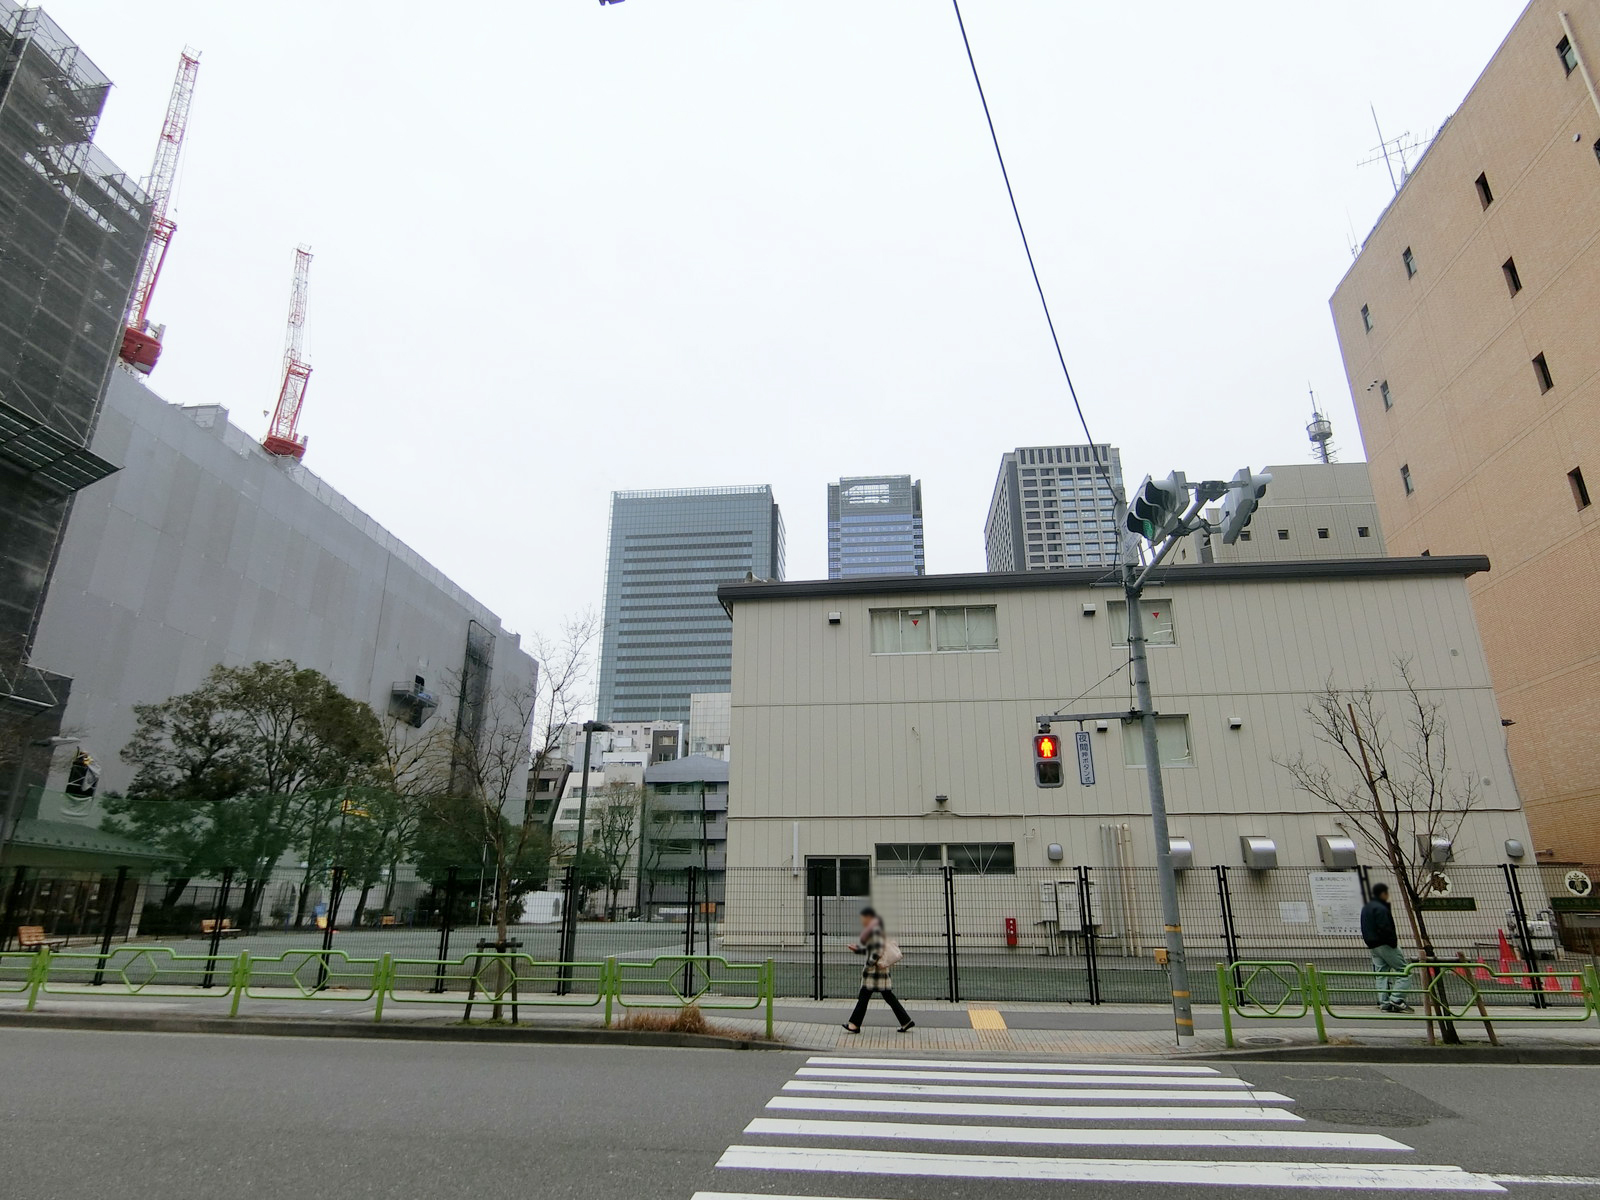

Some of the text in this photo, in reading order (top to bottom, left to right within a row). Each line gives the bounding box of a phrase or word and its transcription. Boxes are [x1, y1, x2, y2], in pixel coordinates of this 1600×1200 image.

[1078, 734, 1091, 782] 夜間押ボタン式
